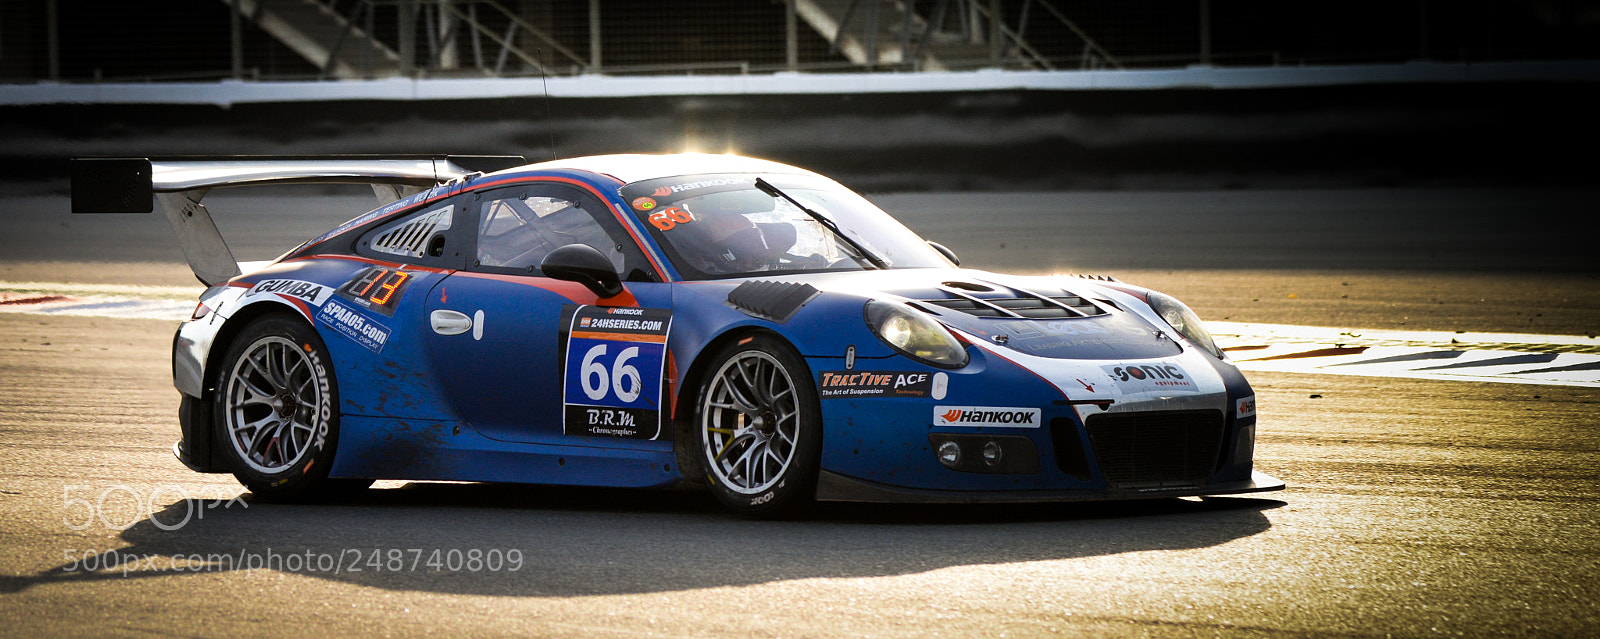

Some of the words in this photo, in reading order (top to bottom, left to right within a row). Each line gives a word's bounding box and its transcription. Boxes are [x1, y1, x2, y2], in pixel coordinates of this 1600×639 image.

[648, 206, 692, 231] 66
[254, 279, 322, 302] GUMBA
[320, 313, 334, 324] RACE
[336, 321, 357, 338] POSITION
[358, 334, 380, 351] DISPLAY
[323, 301, 388, 345] SPAA05.com
[590, 318, 663, 331] 24HSERIES.COM
[580, 344, 642, 403] 66
[893, 374, 928, 389] ACE
[849, 388, 884, 396] Suspension
